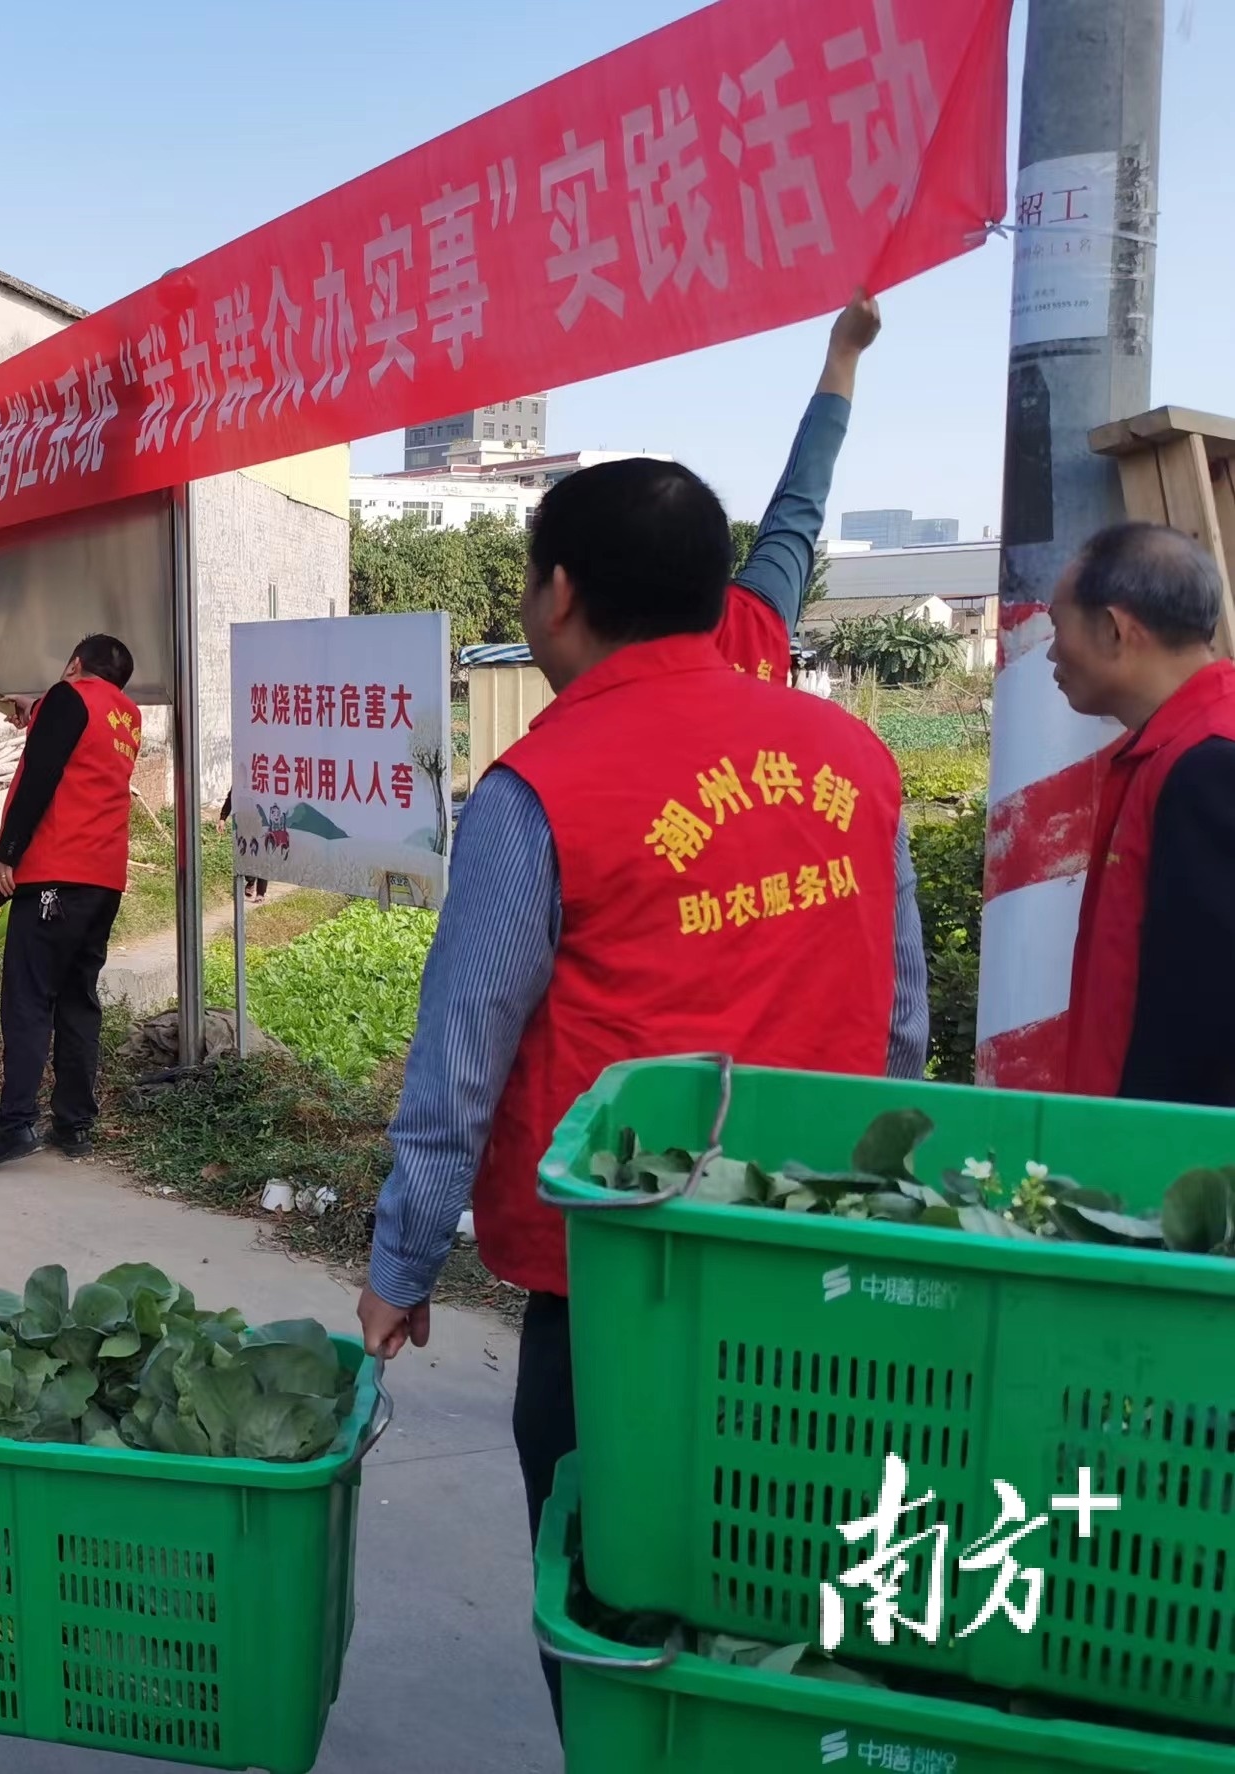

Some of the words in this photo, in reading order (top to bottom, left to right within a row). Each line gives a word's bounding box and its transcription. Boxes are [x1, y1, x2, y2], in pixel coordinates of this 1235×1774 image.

[1017, 186, 1089, 227] 招工
[250, 683, 413, 730] 焚烧秸秆危害大
[251, 753, 414, 809] 综合利用人人夸
[644, 750, 860, 873] 潮州供销
[678, 856, 860, 935] 助农服务队
